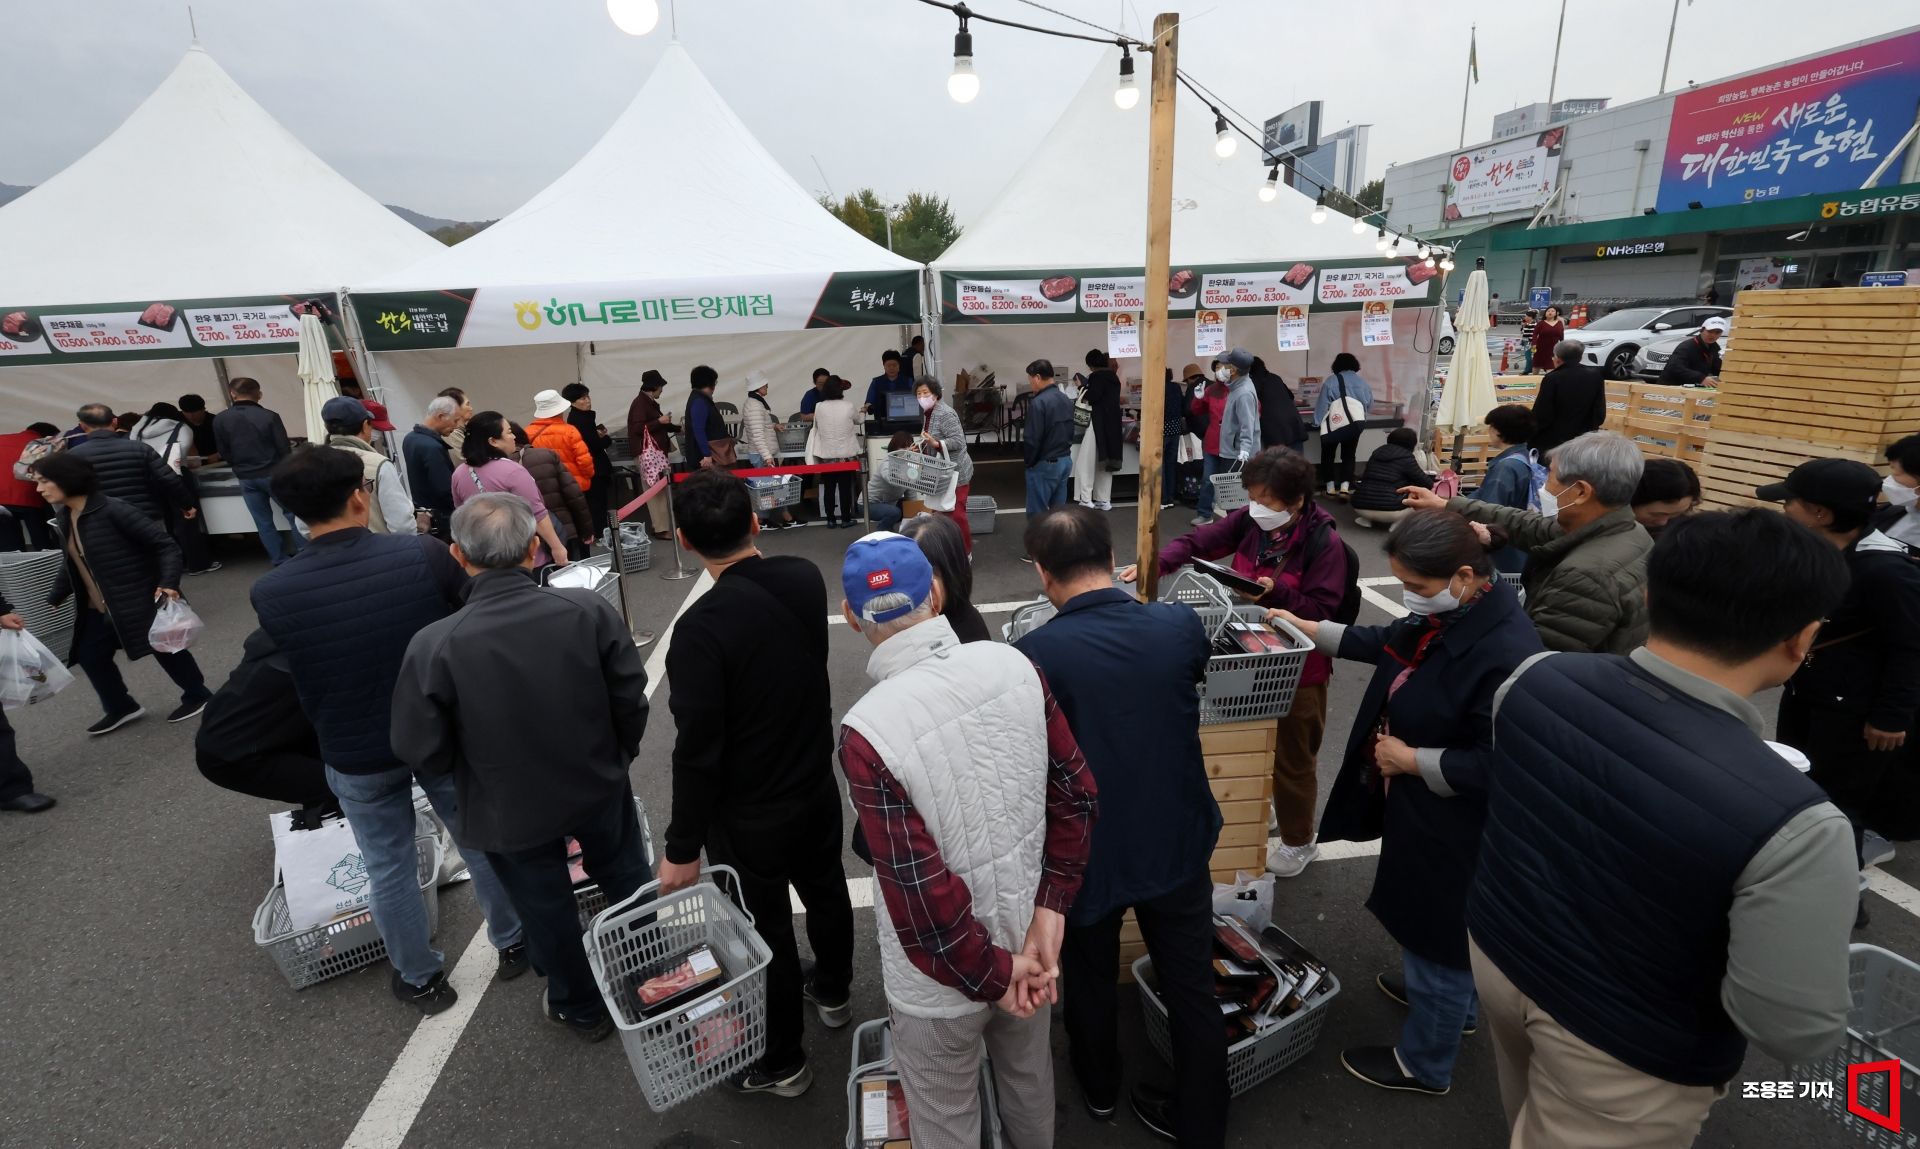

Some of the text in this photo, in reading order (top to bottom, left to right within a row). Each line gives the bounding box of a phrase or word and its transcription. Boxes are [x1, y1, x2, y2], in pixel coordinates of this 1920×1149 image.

[1783, 75, 1808, 88] 농협이
[1811, 60, 1864, 82] 만들어갑니다
[1733, 108, 1769, 125] NEW
[1772, 93, 1848, 136] 새로운
[1697, 123, 1764, 145] 변화와 혁신을 통한
[1681, 119, 1877, 189] 대한민국 농협
[1756, 186, 1780, 199] 농협
[1840, 194, 1920, 216] 농협유통
[1606, 242, 1665, 256] NH농협은행
[850, 286, 895, 311] 특별세일
[243, 312, 266, 320] 국거리
[412, 313, 447, 321] 대한민국이
[413, 321, 449, 333] 먹는 날
